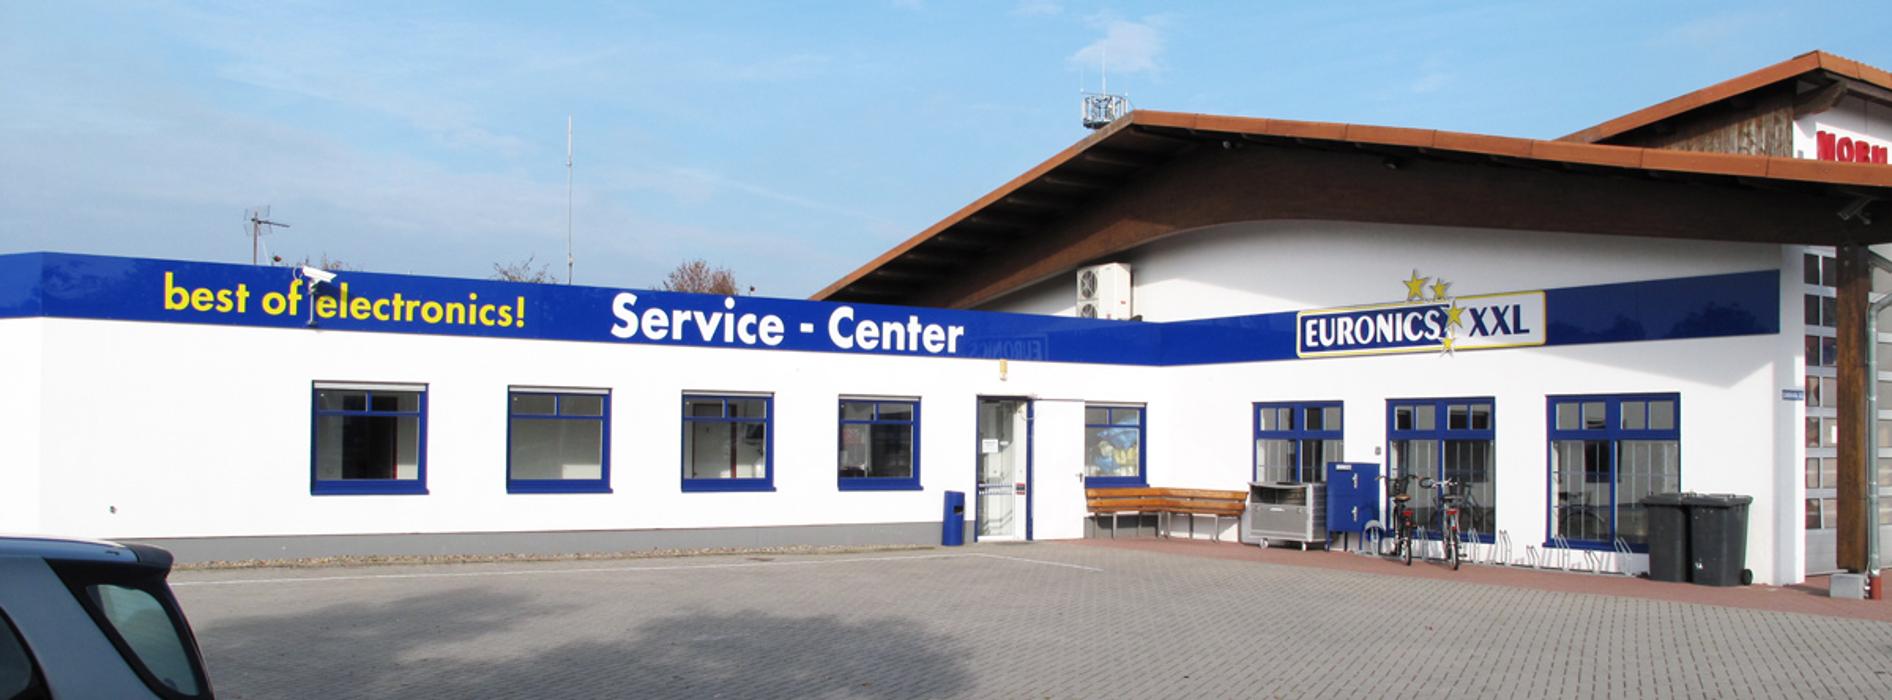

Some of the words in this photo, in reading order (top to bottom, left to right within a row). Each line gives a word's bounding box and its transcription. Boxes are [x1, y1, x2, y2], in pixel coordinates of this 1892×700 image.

[164, 271, 250, 312] best
[262, 279, 303, 315] of
[316, 282, 526, 328] electronics!
[610, 292, 785, 345] Service
[799, 322, 814, 333] -
[828, 305, 965, 353] Center
[1305, 309, 1441, 347] EURONICS
[1468, 304, 1530, 337] XXL
